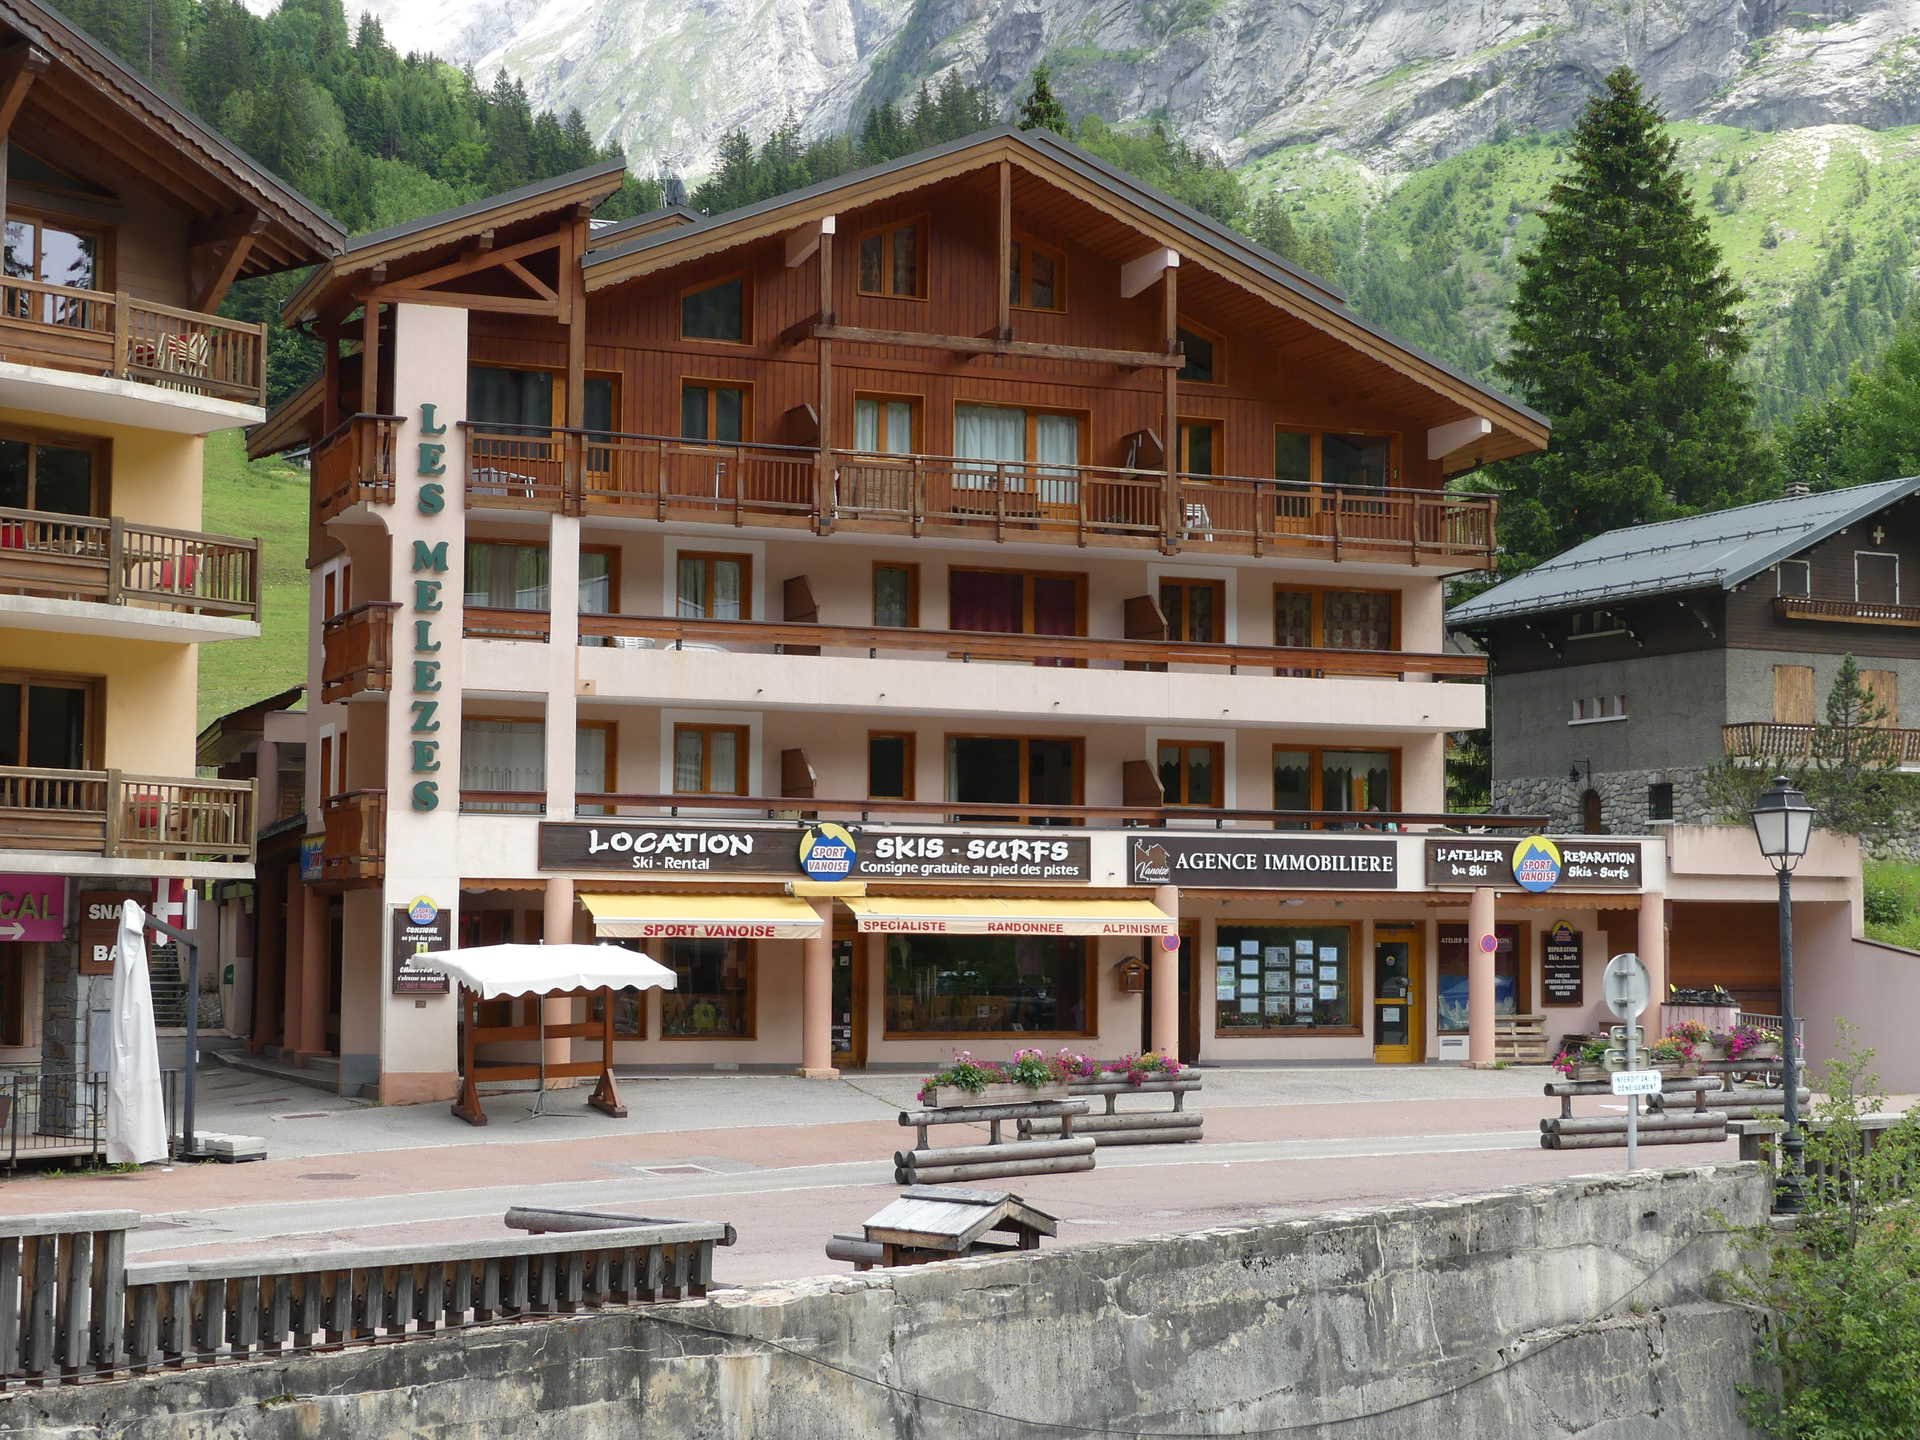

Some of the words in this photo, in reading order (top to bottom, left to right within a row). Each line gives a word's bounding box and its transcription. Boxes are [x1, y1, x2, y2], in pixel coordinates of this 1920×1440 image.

[417, 403, 447, 514] LES
[411, 540, 449, 812] MELEZES
[588, 829, 754, 856] LOCATION
[875, 836, 944, 860] SKIS
[966, 836, 1070, 863] SURFS
[812, 846, 847, 858] SPORT
[1437, 848, 1504, 862] L'ATELIER
[1563, 850, 1636, 865] REPARATION
[632, 856, 654, 869] Ski
[664, 856, 710, 870] Rental
[808, 860, 849, 872] VANOISE
[1175, 852, 1257, 870] AGENCE
[1264, 853, 1394, 872] IMMOBILIERE
[1523, 860, 1551, 870] SPORT
[860, 861, 919, 877] Consigne
[921, 863, 970, 879] gratuite
[973, 866, 987, 875] au
[990, 863, 1018, 878] pied
[1020, 863, 1042, 876] des
[1044, 864, 1079, 878] pistes
[1451, 866, 1467, 876] du
[1469, 865, 1487, 877] Ski
[1520, 871, 1556, 881] VANOISE
[1567, 866, 1593, 878] Skis
[1599, 866, 1630, 879] Surfs
[643, 924, 698, 937] SPORT
[704, 925, 775, 938] VANOISE
[863, 920, 946, 932] SPECIALISTE
[987, 922, 1063, 933] RANDONNEE
[1103, 924, 1169, 935] ALPINISME
[93, 945, 117, 961] BA
